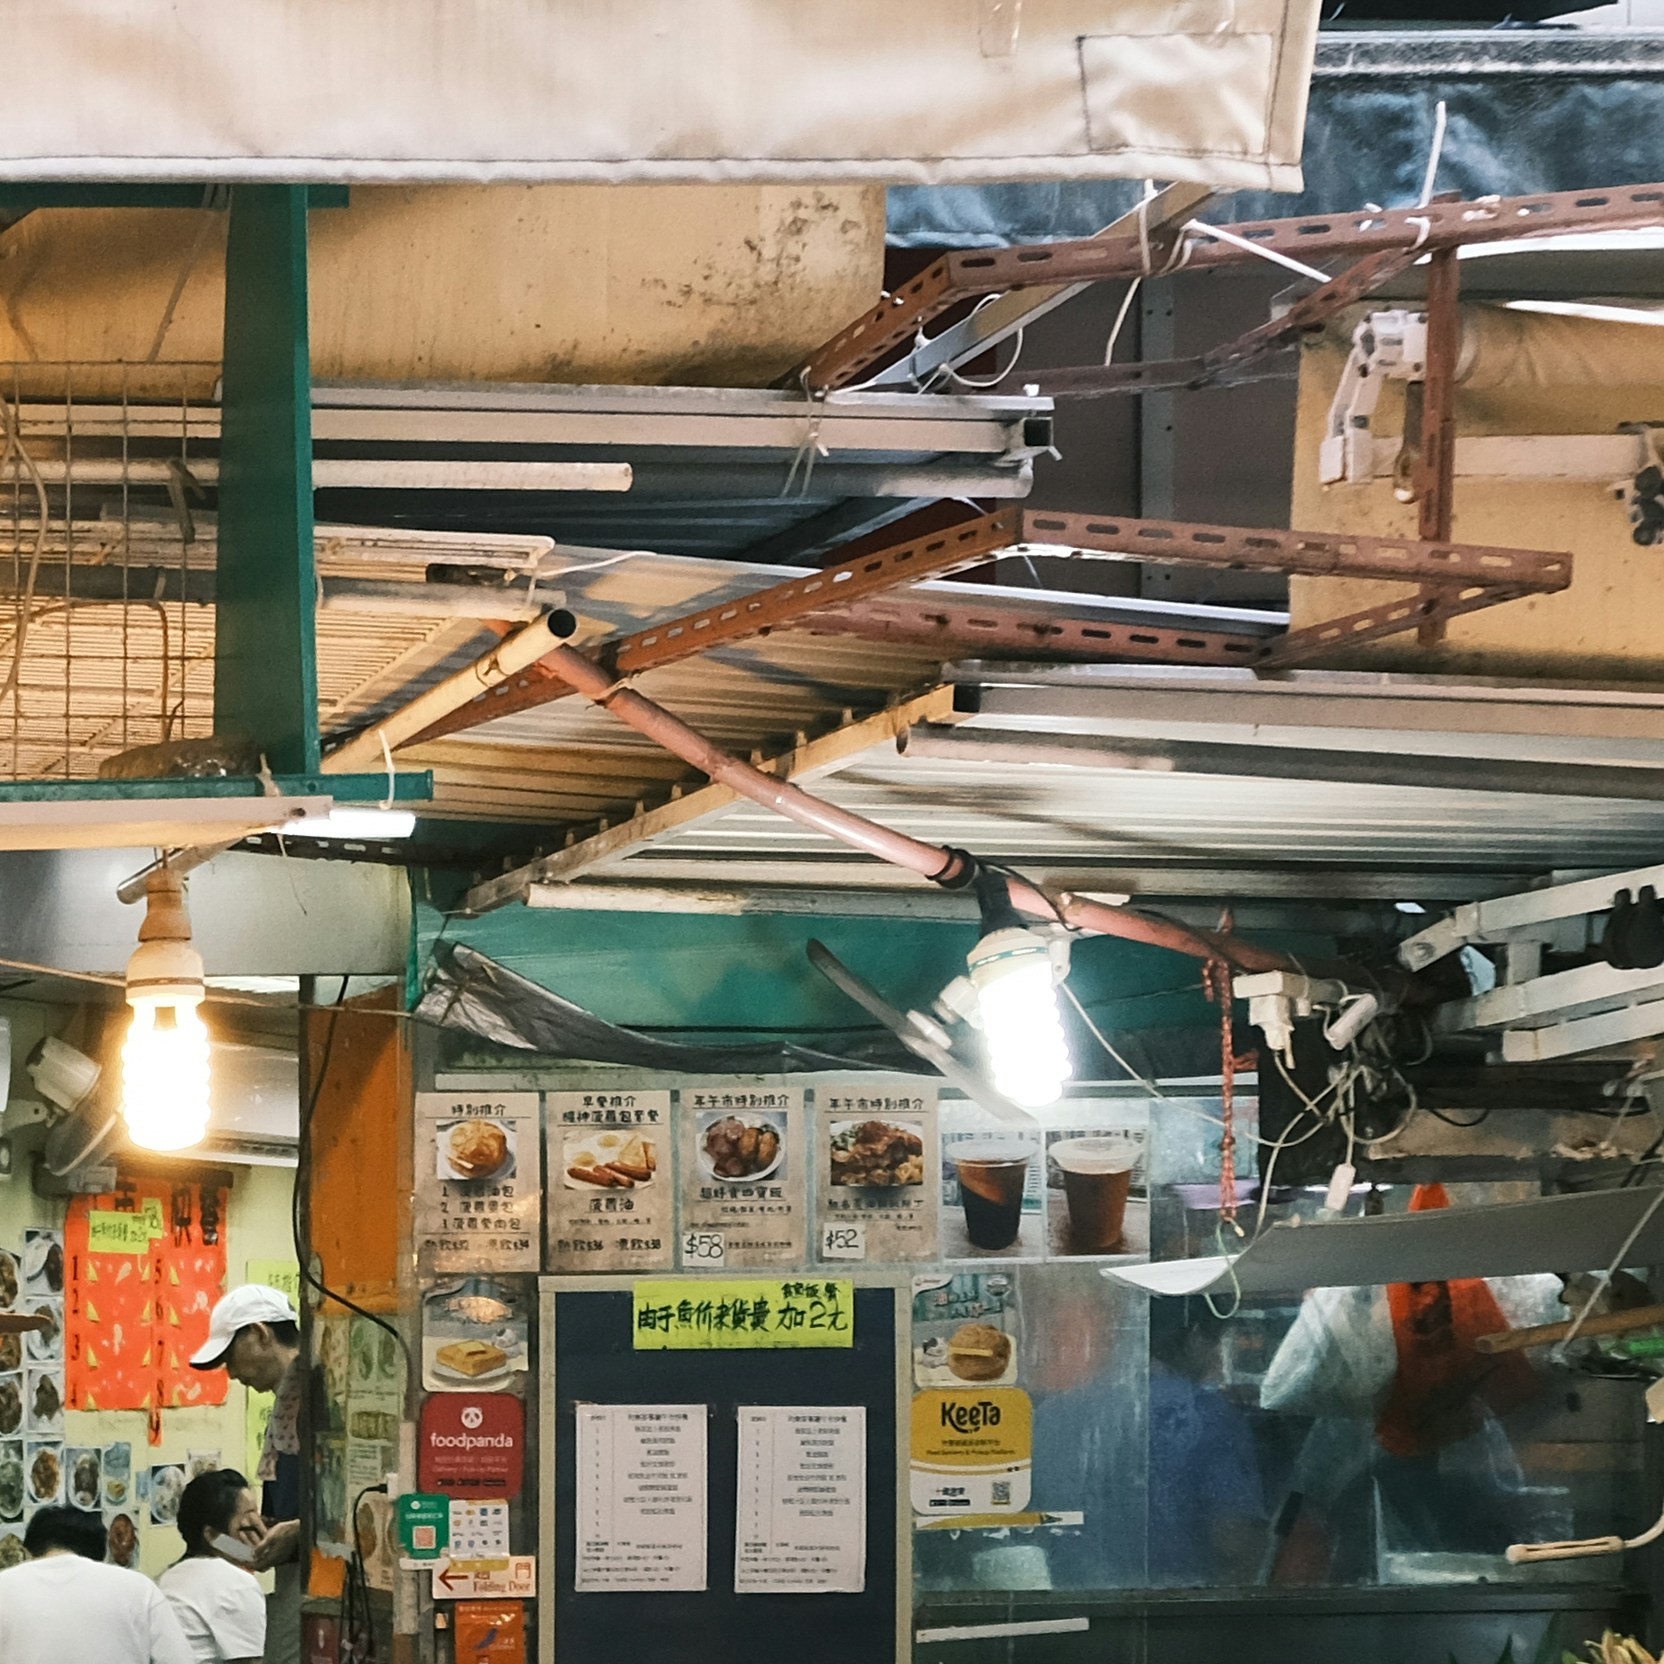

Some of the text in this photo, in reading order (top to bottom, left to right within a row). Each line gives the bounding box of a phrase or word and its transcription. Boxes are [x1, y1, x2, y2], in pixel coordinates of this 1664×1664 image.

[684, 1233, 724, 1258] $58
[824, 1228, 859, 1250] $52
[430, 1432, 513, 1451] foodpanda
